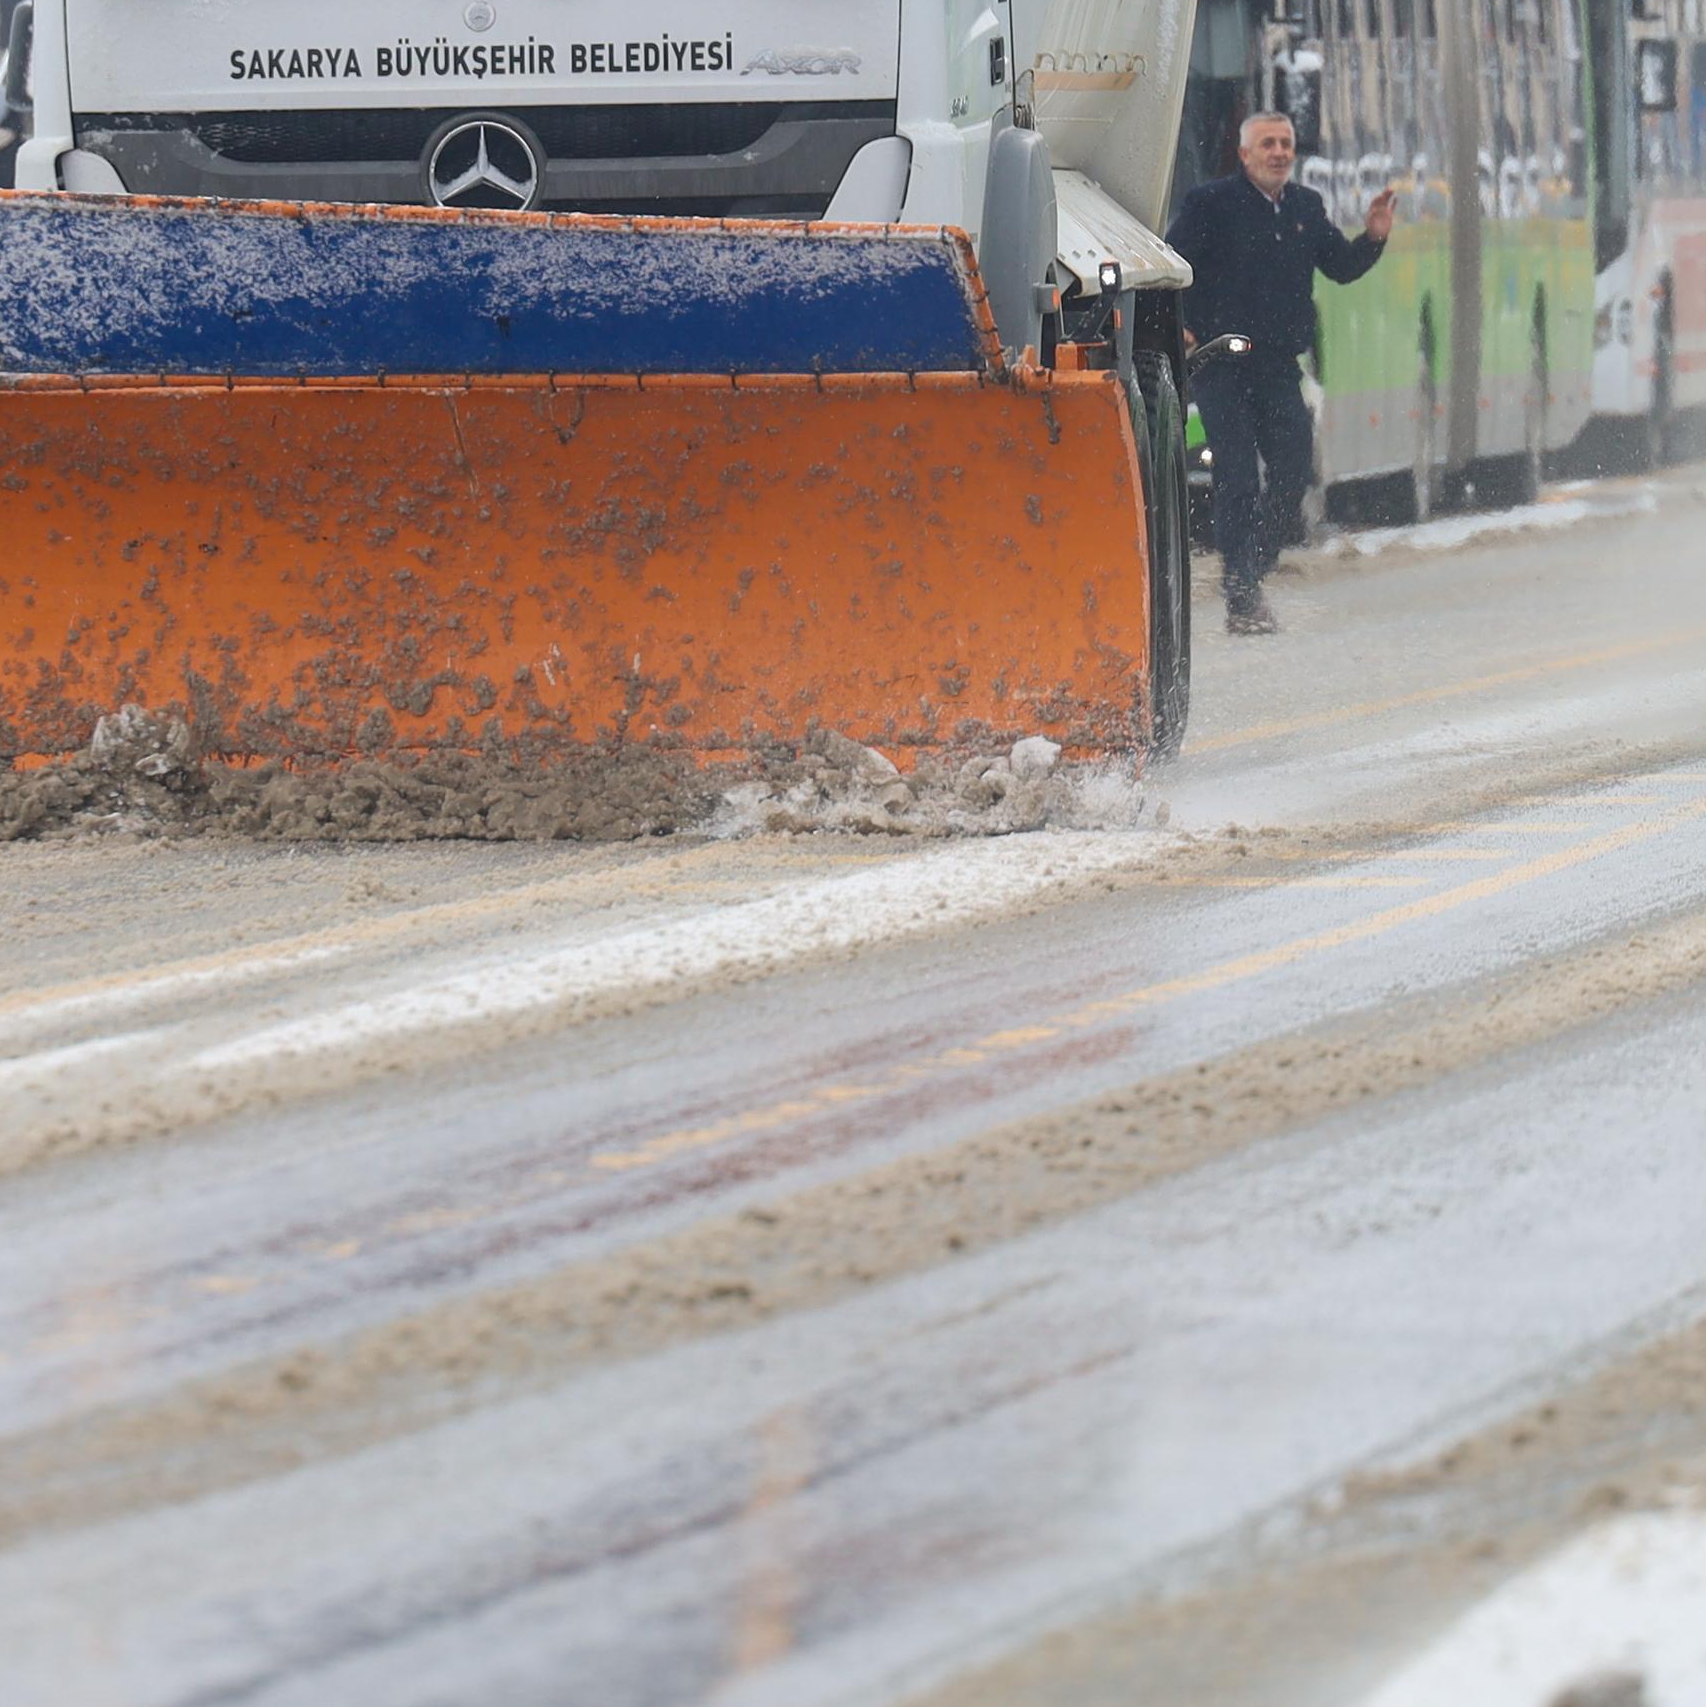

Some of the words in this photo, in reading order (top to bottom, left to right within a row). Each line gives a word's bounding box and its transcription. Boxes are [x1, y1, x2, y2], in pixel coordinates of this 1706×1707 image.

[230, 48, 362, 79] SAKARYA
[377, 36, 555, 79] BÜYÜKŞEHİR
[571, 32, 733, 73] BELEDİYESİ
